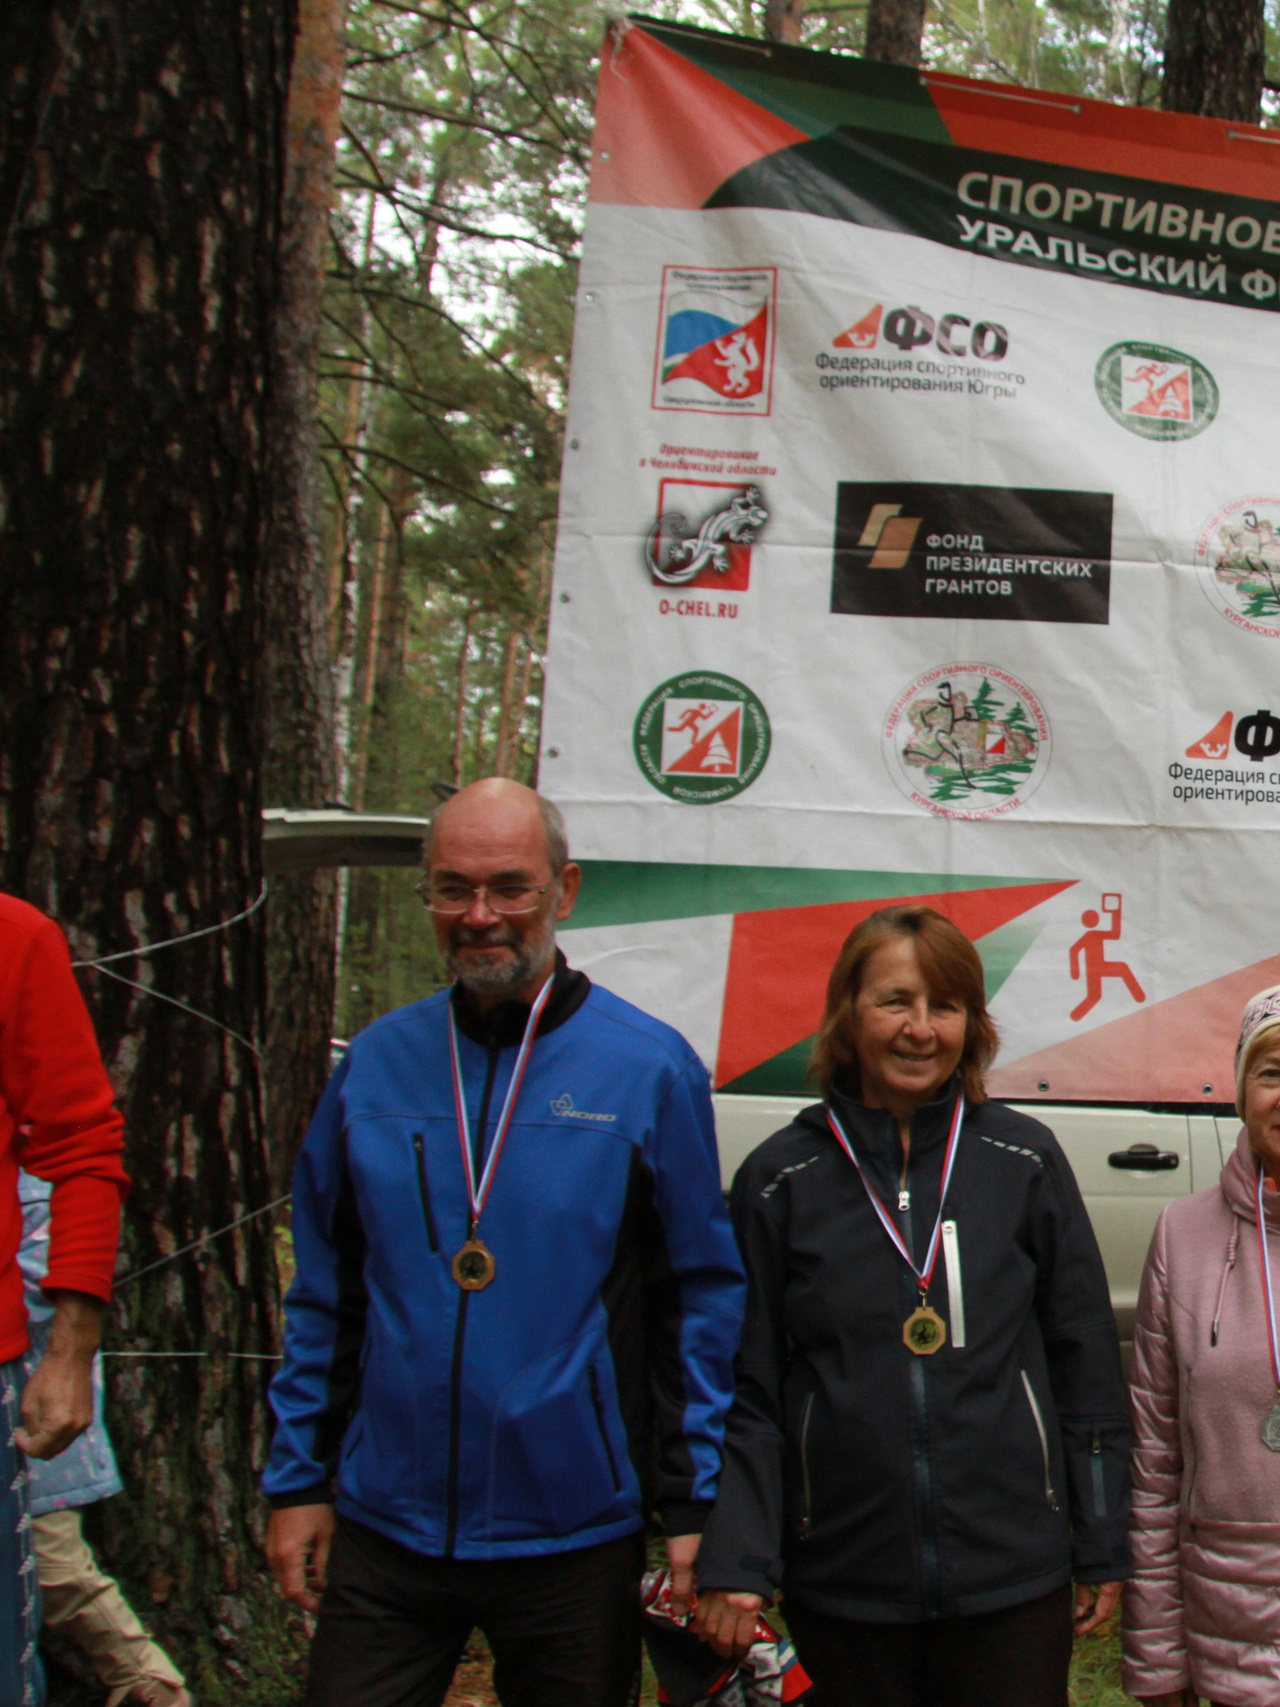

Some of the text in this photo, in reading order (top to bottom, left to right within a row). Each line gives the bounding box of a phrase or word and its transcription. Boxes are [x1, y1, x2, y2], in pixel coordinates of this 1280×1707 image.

[956, 214, 1227, 294] УРАЛЬСКИЙ
[883, 304, 1008, 361] ФСО
[815, 352, 1025, 385] Федерация спортивного
[819, 374, 1017, 399] ориентирования Югры
[926, 534, 984, 551] ФОНД
[925, 556, 1092, 578] ПРЕЗИДЕНТСКИХ
[925, 578, 1013, 595] ГРАНТОВ
[917, 664, 987, 687] СПОРТИВНОГО
[988, 668, 1048, 741] ОРИЕНТИРОВАНИЯ
[1168, 762, 1265, 785] Федерация
[910, 791, 1021, 821] КУРГАНСКОЙ ОБЛАСТИ
